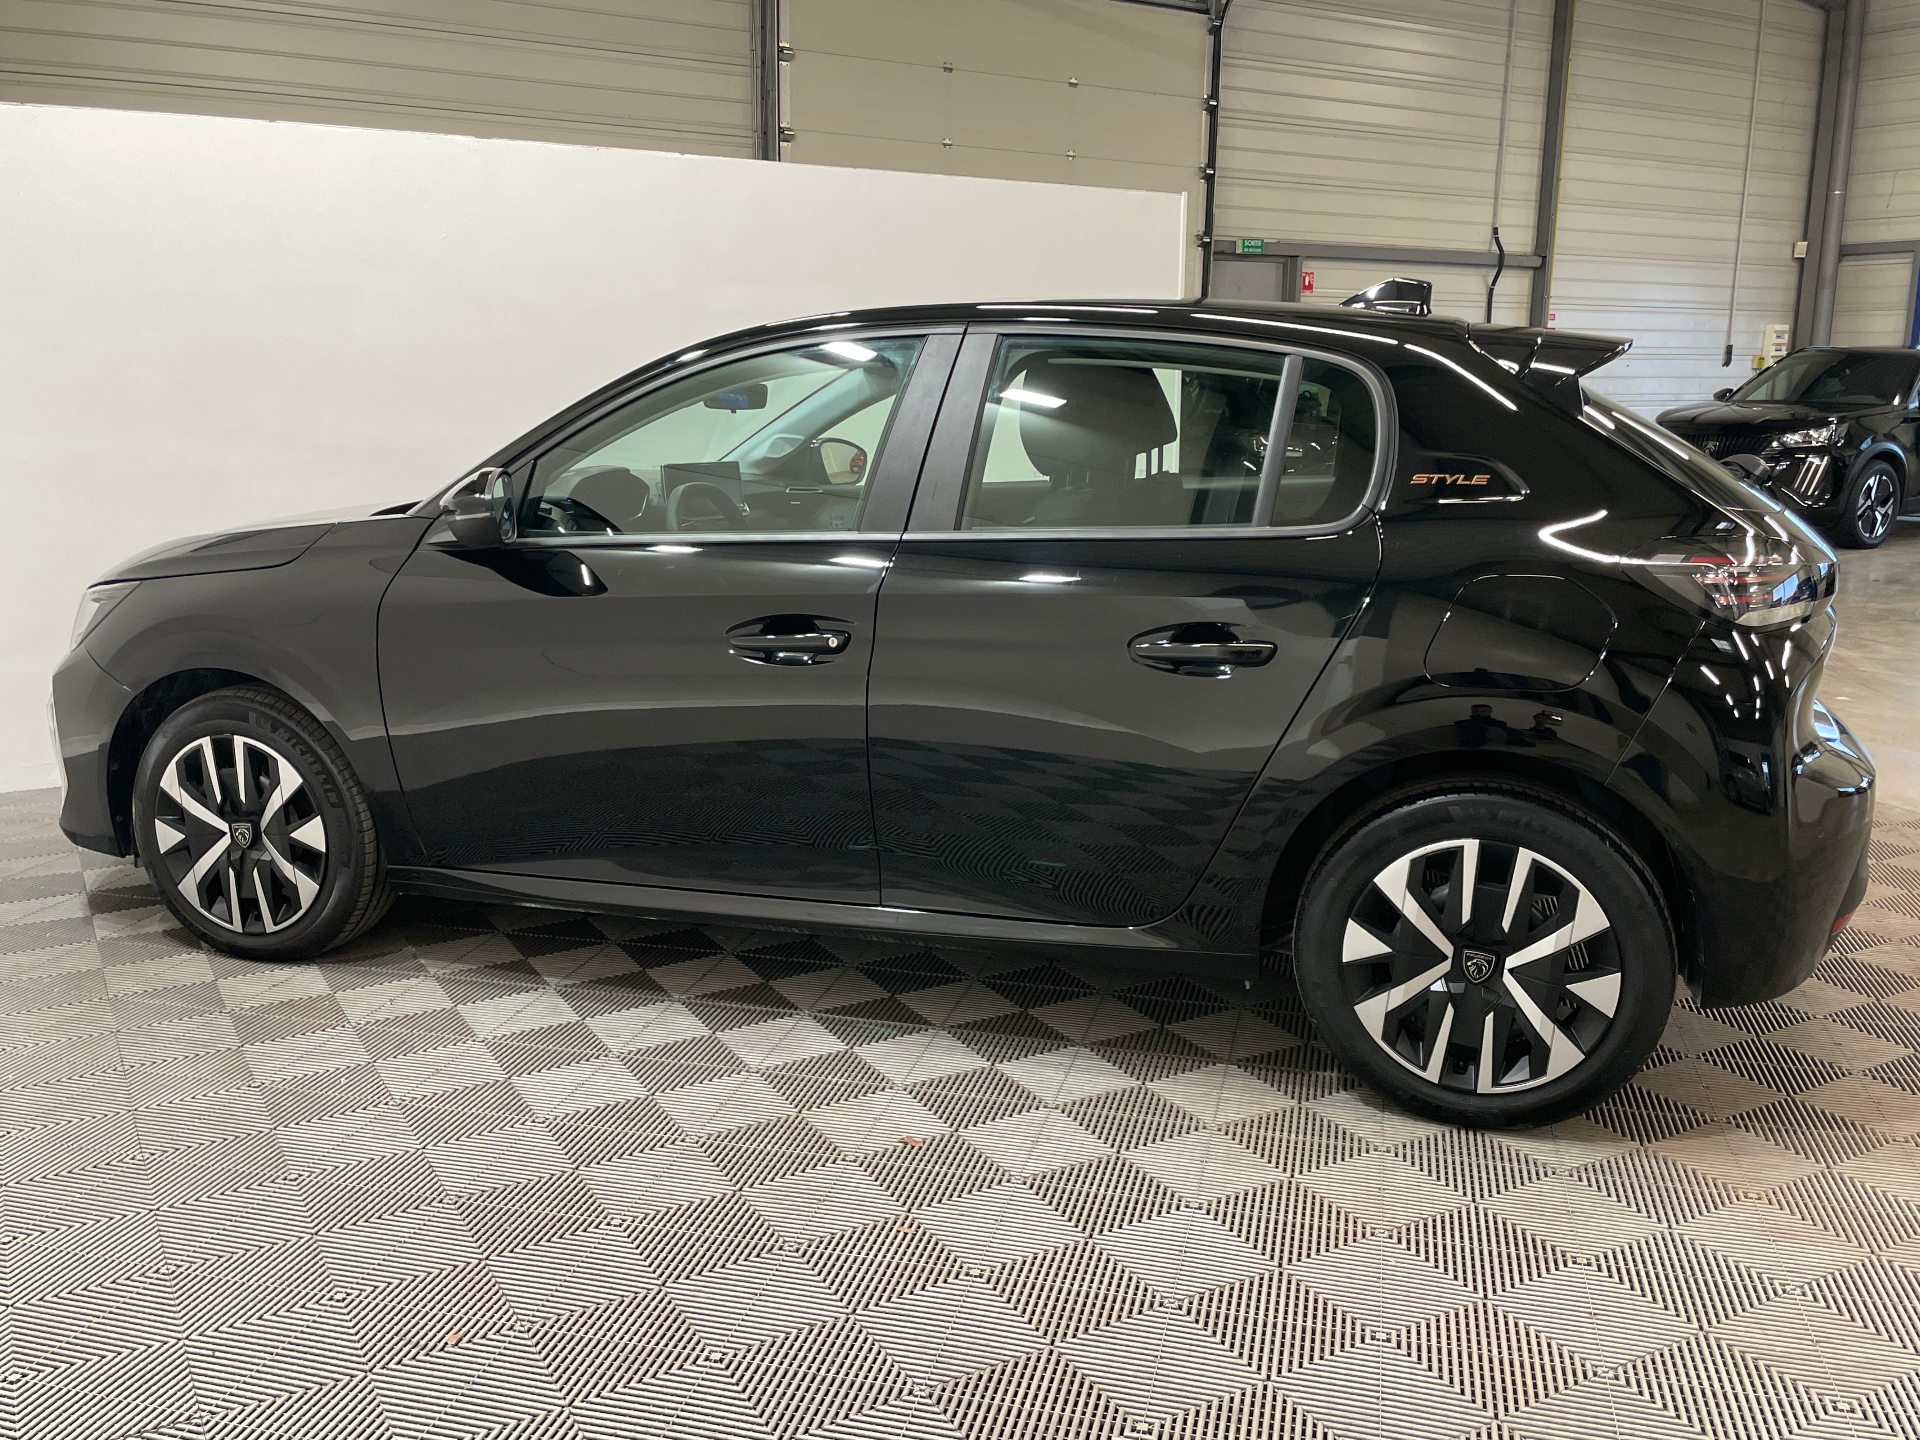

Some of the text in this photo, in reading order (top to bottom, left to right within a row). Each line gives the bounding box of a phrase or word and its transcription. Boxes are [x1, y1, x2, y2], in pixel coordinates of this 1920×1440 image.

[1244, 239, 1262, 247] SORTIE
[1410, 473, 1491, 485] STYLE
[274, 727, 339, 803] MICHELIN
